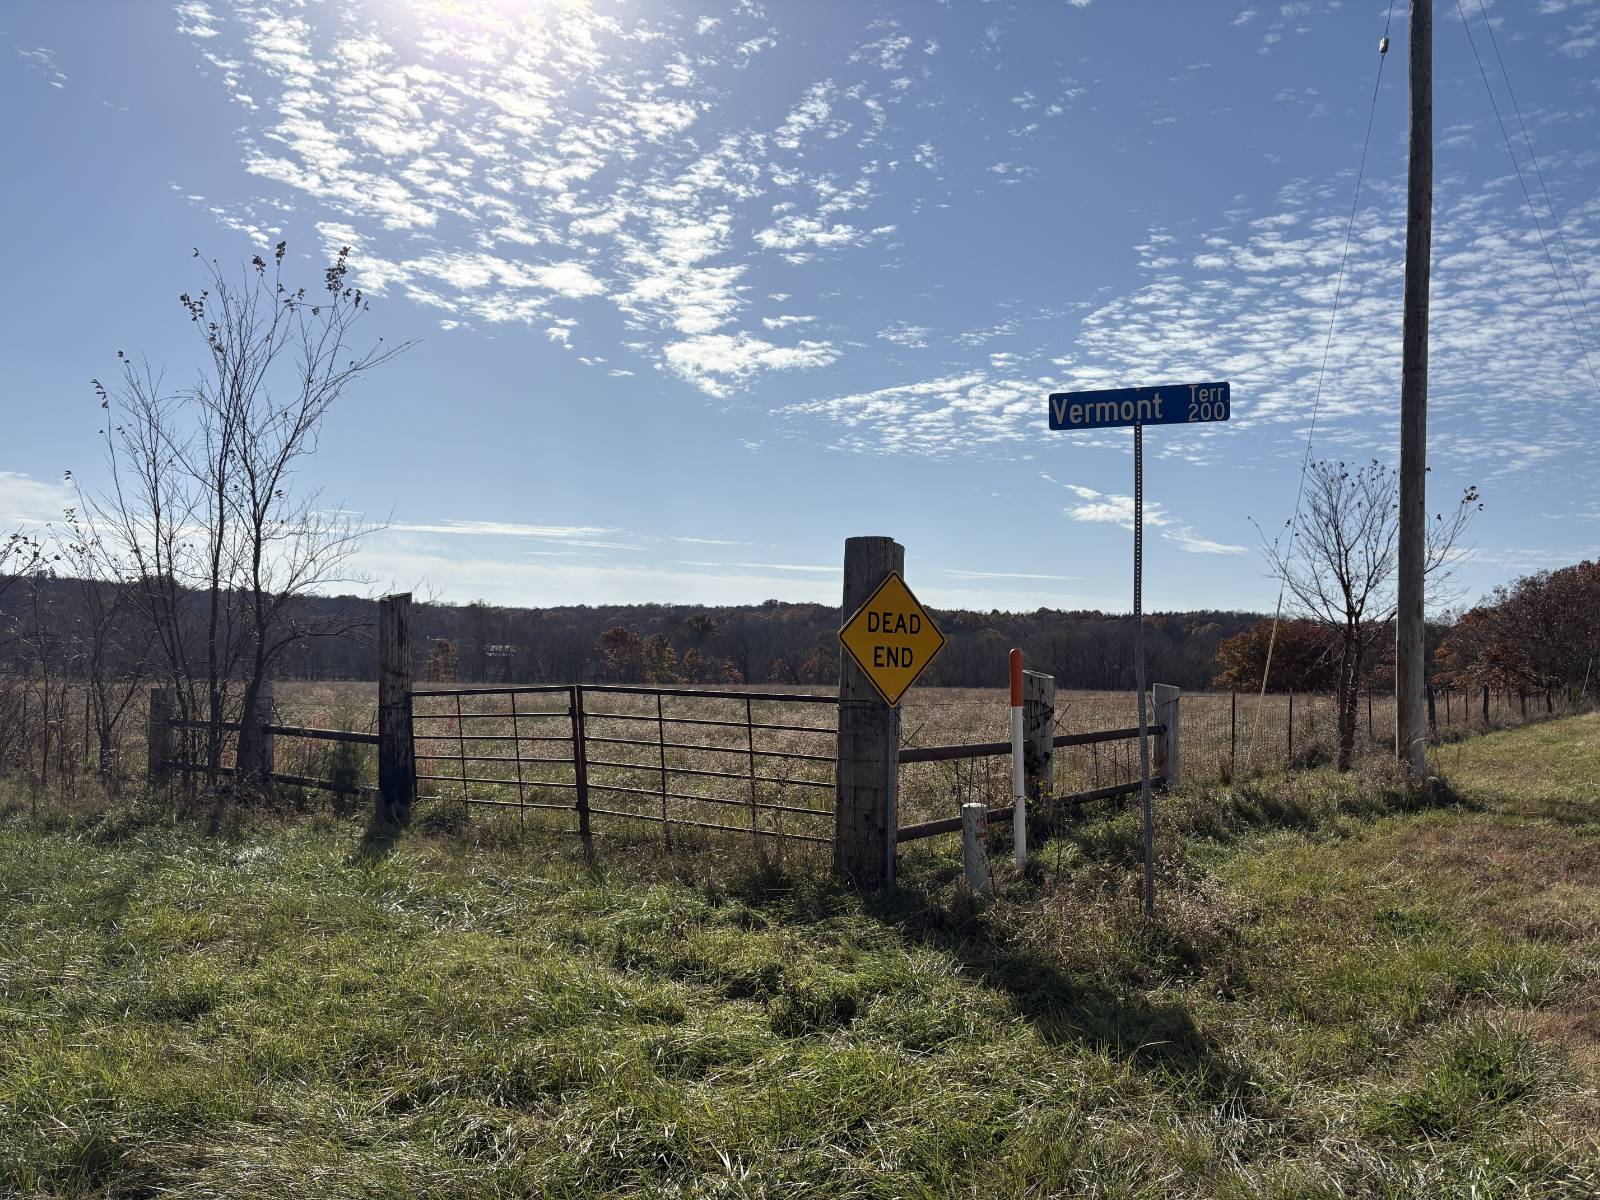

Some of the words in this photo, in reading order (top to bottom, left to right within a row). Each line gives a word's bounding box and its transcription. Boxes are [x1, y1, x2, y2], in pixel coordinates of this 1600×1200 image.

[1188, 384, 1225, 403] Terr
[1052, 392, 1163, 425] Vermont
[1188, 402, 1226, 422] 200
[867, 611, 921, 635] DEAD
[873, 645, 913, 668] END
